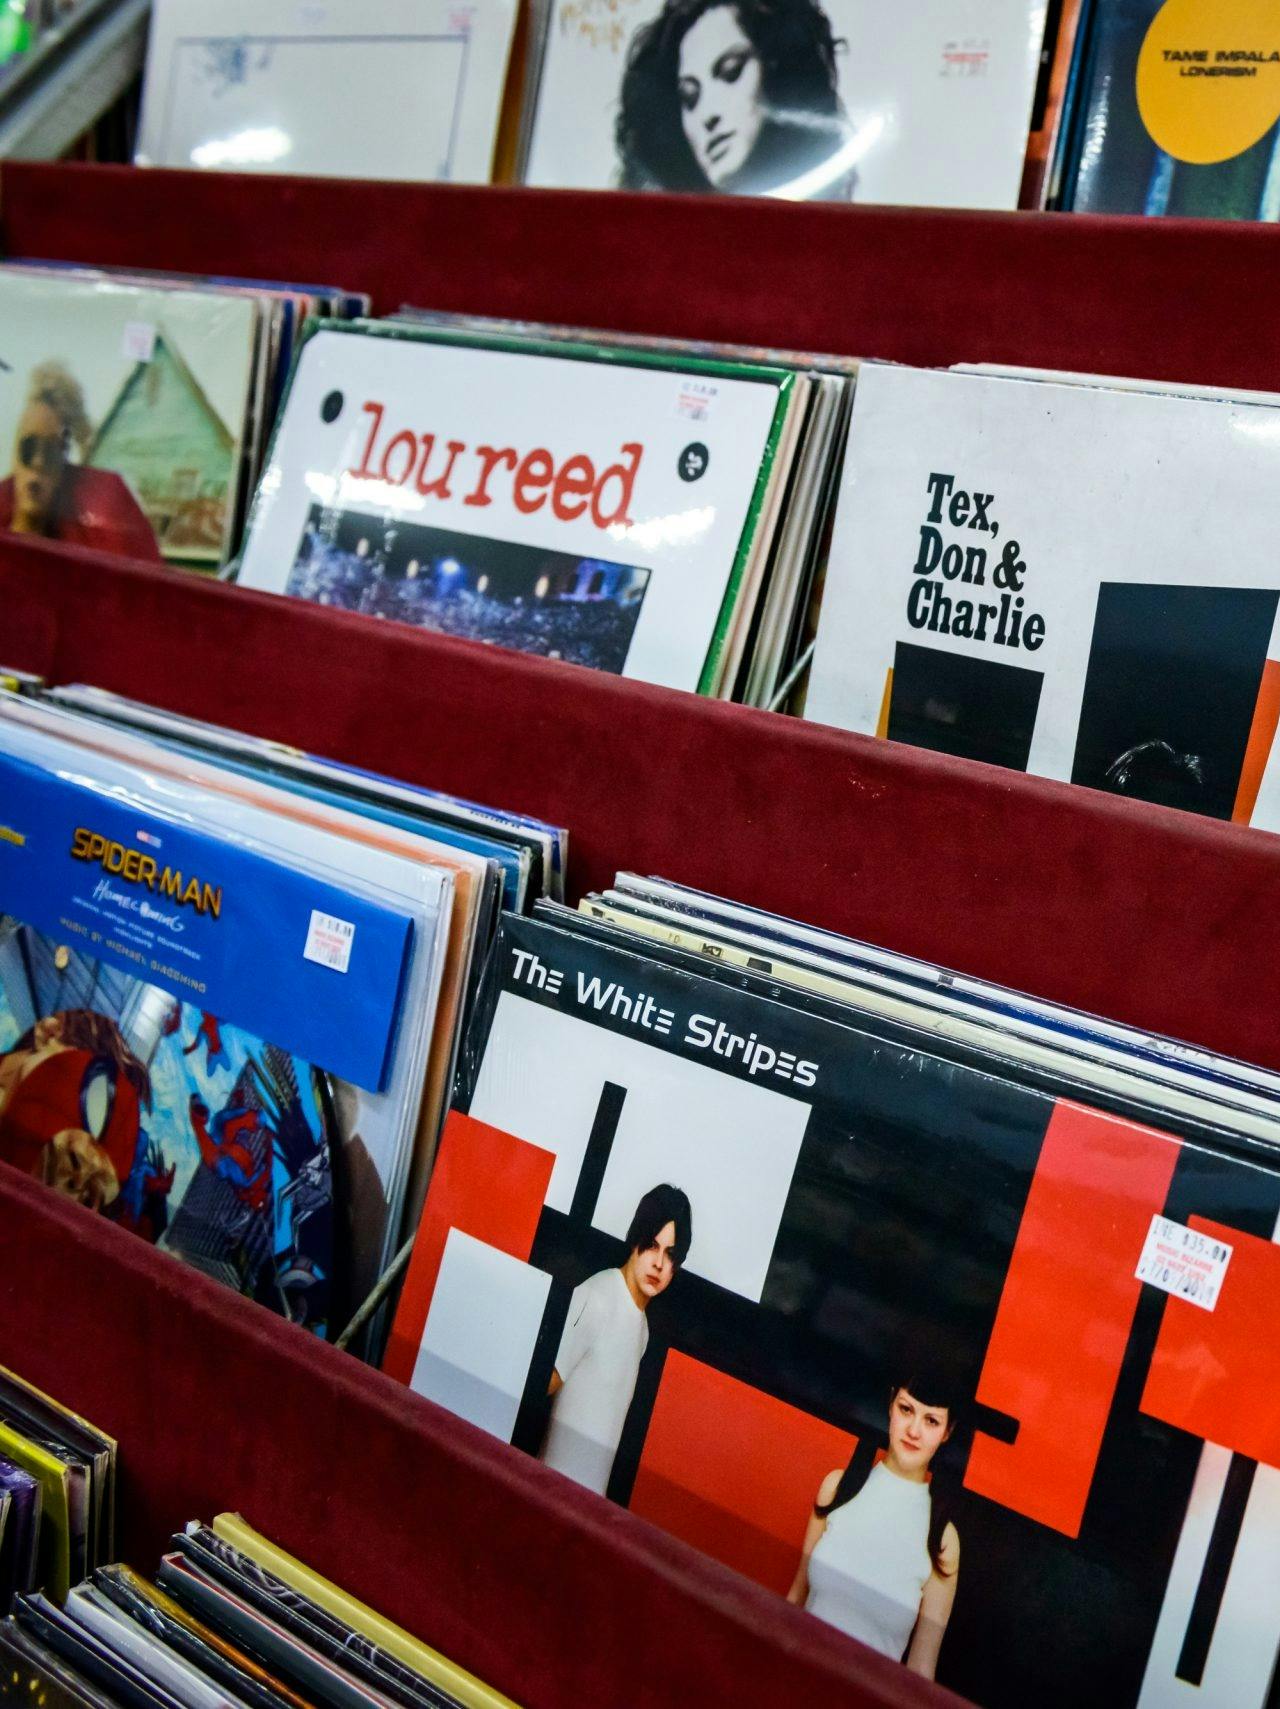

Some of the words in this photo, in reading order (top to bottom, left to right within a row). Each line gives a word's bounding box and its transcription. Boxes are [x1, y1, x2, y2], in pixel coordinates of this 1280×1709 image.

[1163, 50, 1208, 61] TAME
[1215, 50, 1280, 62] IMPALA
[1180, 66, 1257, 77] LONERISM
[351, 402, 464, 500] lou
[463, 443, 643, 529] reed
[927, 473, 999, 539] Tex,
[913, 525, 987, 586] Don
[993, 540, 1026, 592] &
[907, 578, 1045, 651] Charlie
[71, 828, 222, 918] SPIDER-MAN
[511, 948, 564, 995] The
[576, 972, 674, 1035] White
[684, 1013, 819, 1087] Stripes
